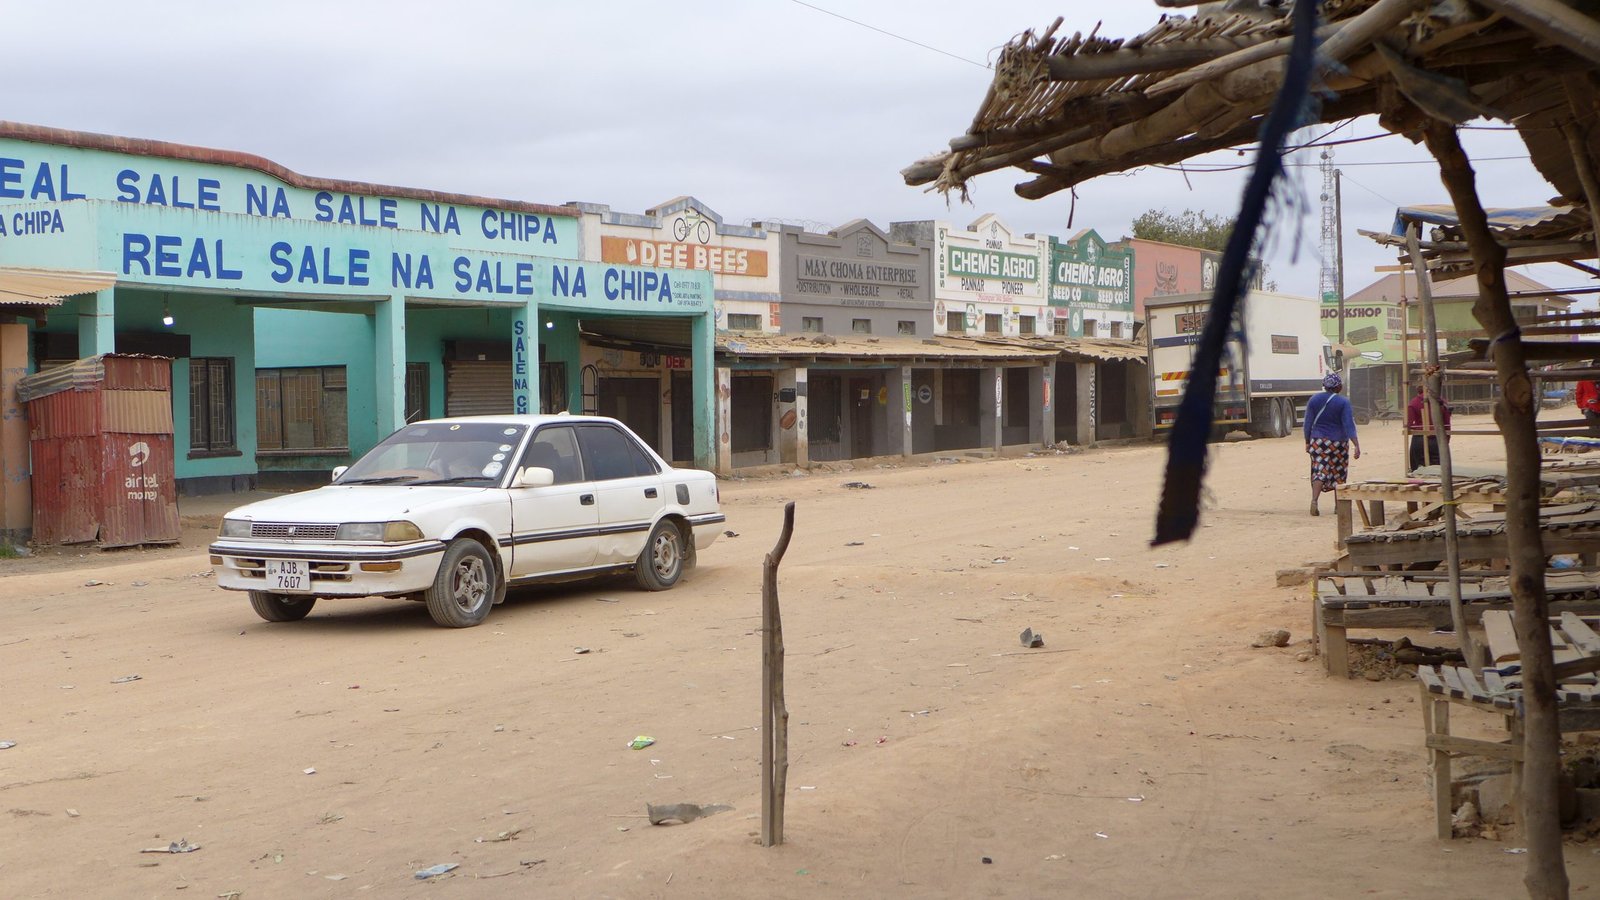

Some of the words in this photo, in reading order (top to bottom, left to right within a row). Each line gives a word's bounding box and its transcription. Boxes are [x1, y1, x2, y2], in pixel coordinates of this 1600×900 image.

[116, 169, 221, 211] SALE
[245, 183, 291, 218] NA
[315, 191, 398, 228] SALE
[420, 203, 461, 236] NA
[481, 208, 558, 245] CHIPA
[13, 208, 65, 236] CHIPA
[985, 239, 1004, 250] PANNAR
[640, 240, 688, 269] DEE
[693, 245, 748, 274] BEES
[122, 233, 243, 280] REAL
[269, 241, 370, 286] SALE
[391, 252, 434, 290] NA
[454, 256, 534, 296] SALE
[552, 265, 587, 298] NA
[604, 267, 673, 303] CHIPA
[804, 259, 828, 278] MAX
[830, 261, 864, 280] CHOMA
[866, 265, 917, 284] ENTERPRISE
[1002, 256, 1035, 280] AGRO
[1097, 266, 1124, 288] AGRO
[798, 281, 832, 295] DISTRIBUTION
[843, 284, 880, 297] WHOLESALE
[961, 277, 985, 292] PANNAR
[1001, 281, 1024, 295] PIONEER
[1052, 285, 1070, 300] SEED
[1071, 287, 1082, 301] CO
[1098, 290, 1114, 304] SEED
[1114, 291, 1124, 304] CO
[1320, 307, 1382, 319] WOKSHOP
[514, 320, 526, 375] SALE
[514, 378, 528, 390] NA
[124, 473, 159, 488] airtel
[280, 561, 298, 574] AJB
[278, 575, 301, 589] 7607
